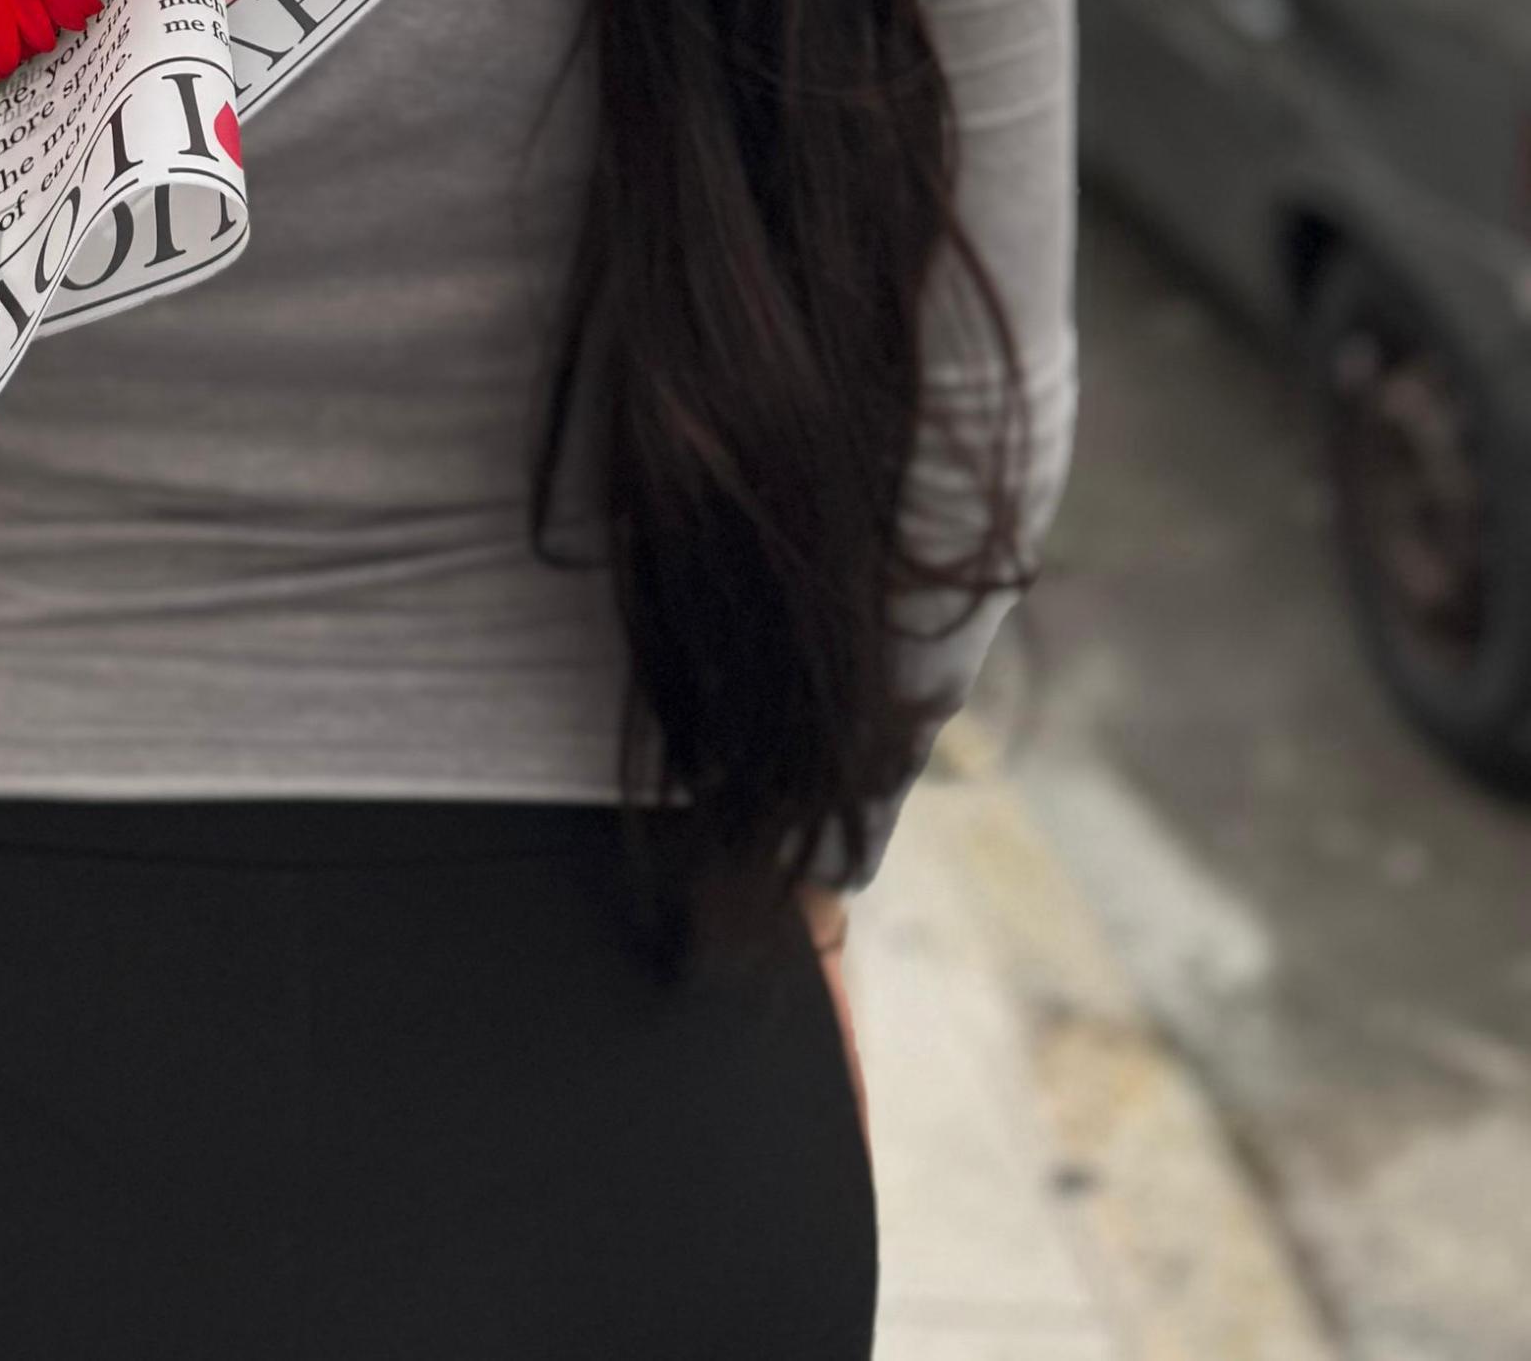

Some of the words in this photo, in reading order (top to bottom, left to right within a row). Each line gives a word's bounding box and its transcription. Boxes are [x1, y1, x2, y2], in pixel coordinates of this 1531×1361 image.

[44, 29, 91, 89] you
[164, 17, 206, 35] me
[39, 122, 86, 193] each
[91, 50, 133, 114] one.
[41, 15, 131, 156] meaning
